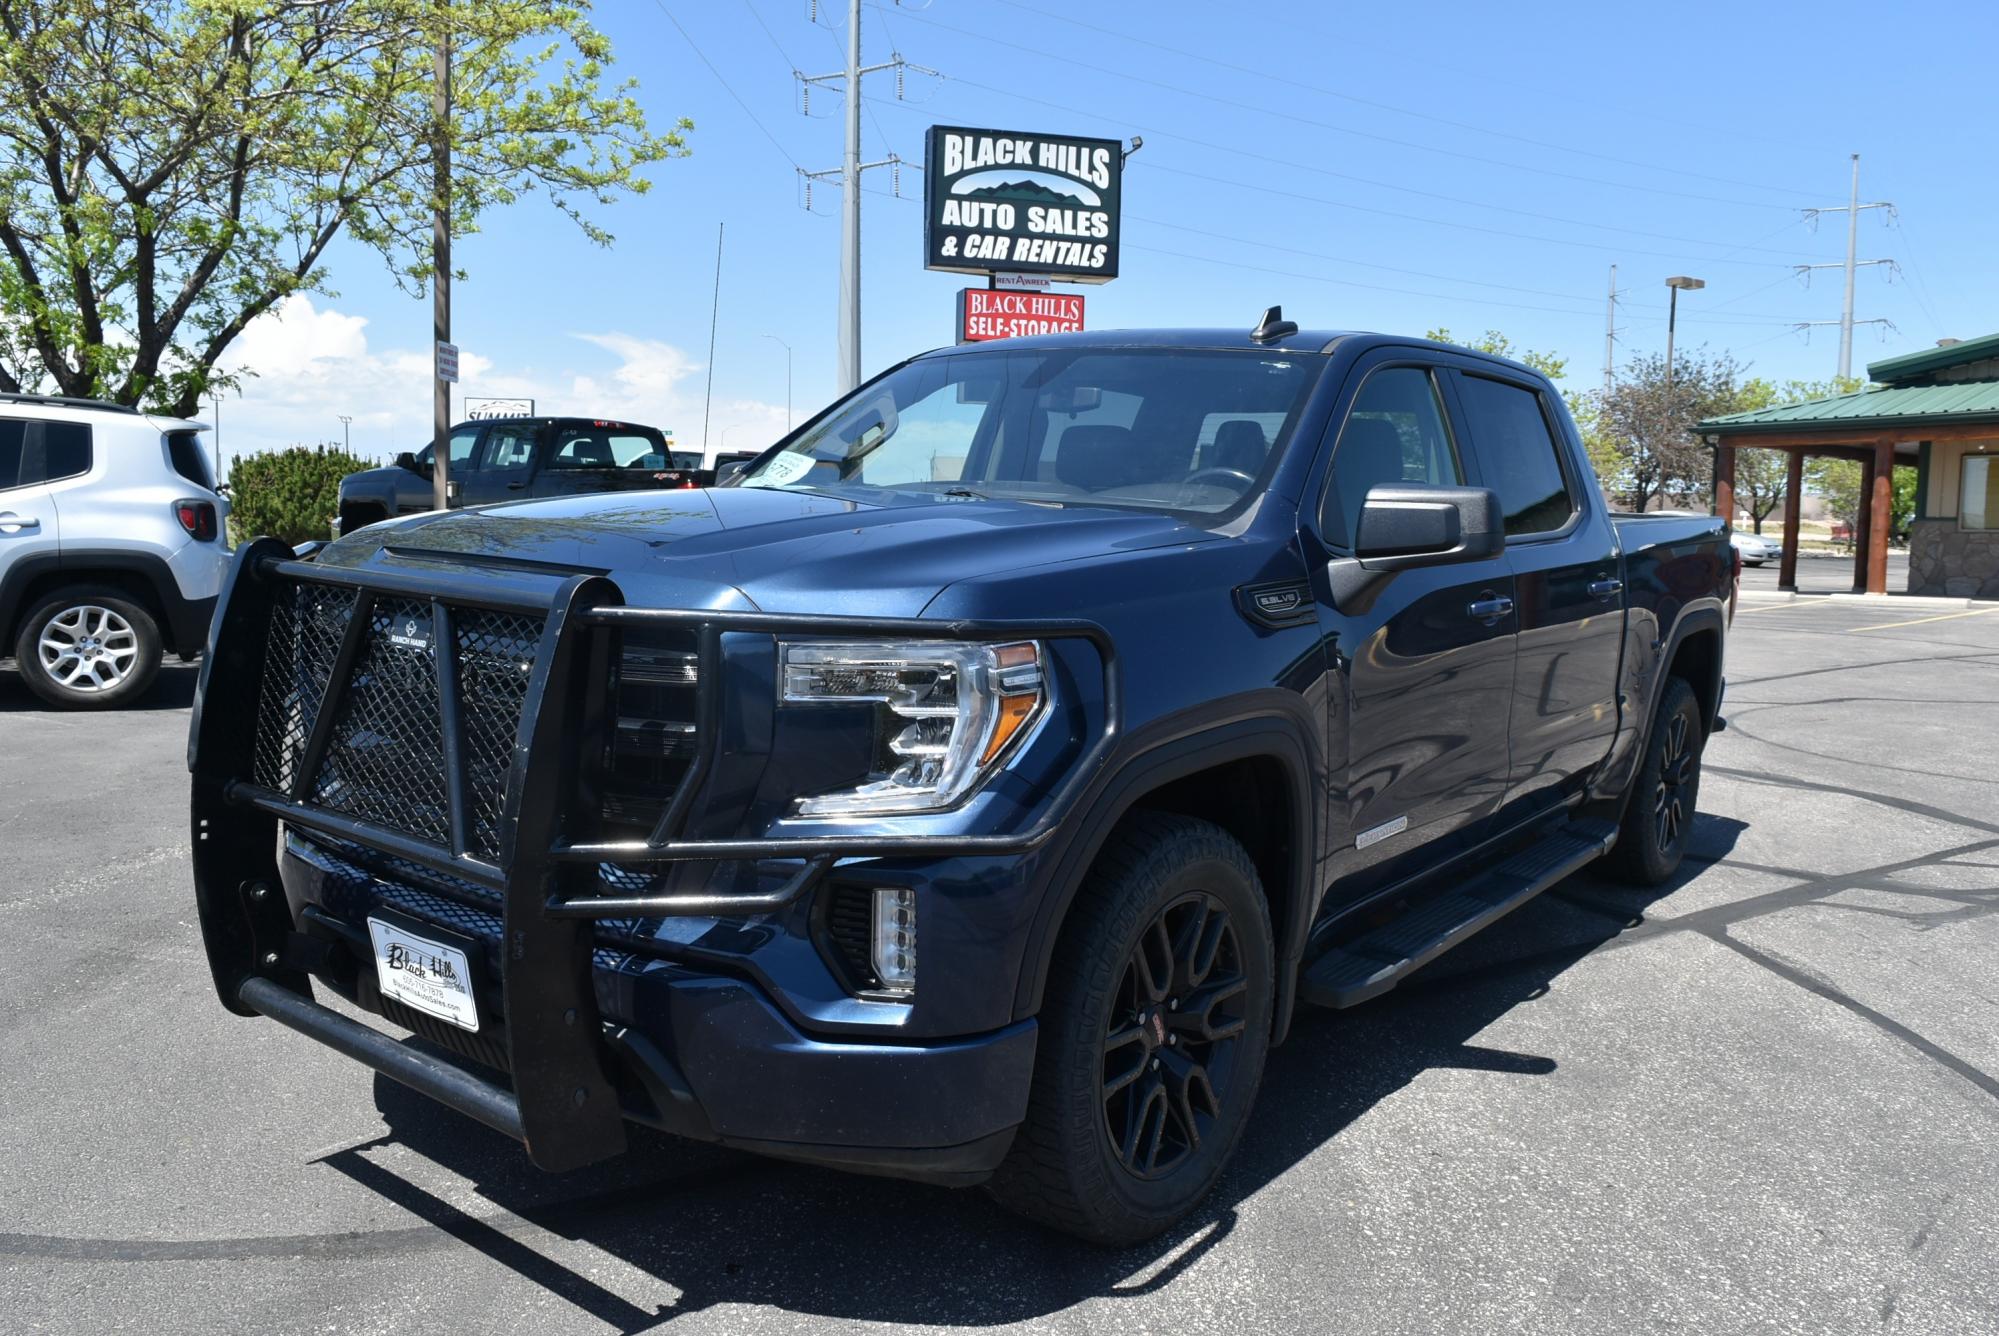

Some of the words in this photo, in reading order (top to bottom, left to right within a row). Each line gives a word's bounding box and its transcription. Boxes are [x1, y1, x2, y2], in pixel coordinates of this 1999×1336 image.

[944, 134, 1033, 177] BLACK
[1039, 142, 1109, 190] HILLS
[941, 199, 1015, 230] AUTO
[1027, 206, 1109, 238] SALES
[941, 236, 958, 256] &
[963, 234, 1010, 260] CAR
[1012, 237, 1108, 268] RENTALS
[970, 293, 1027, 314] BLACK
[1032, 297, 1079, 321] HILLS
[385, 943, 427, 979] Black
[430, 955, 457, 980] Hills
